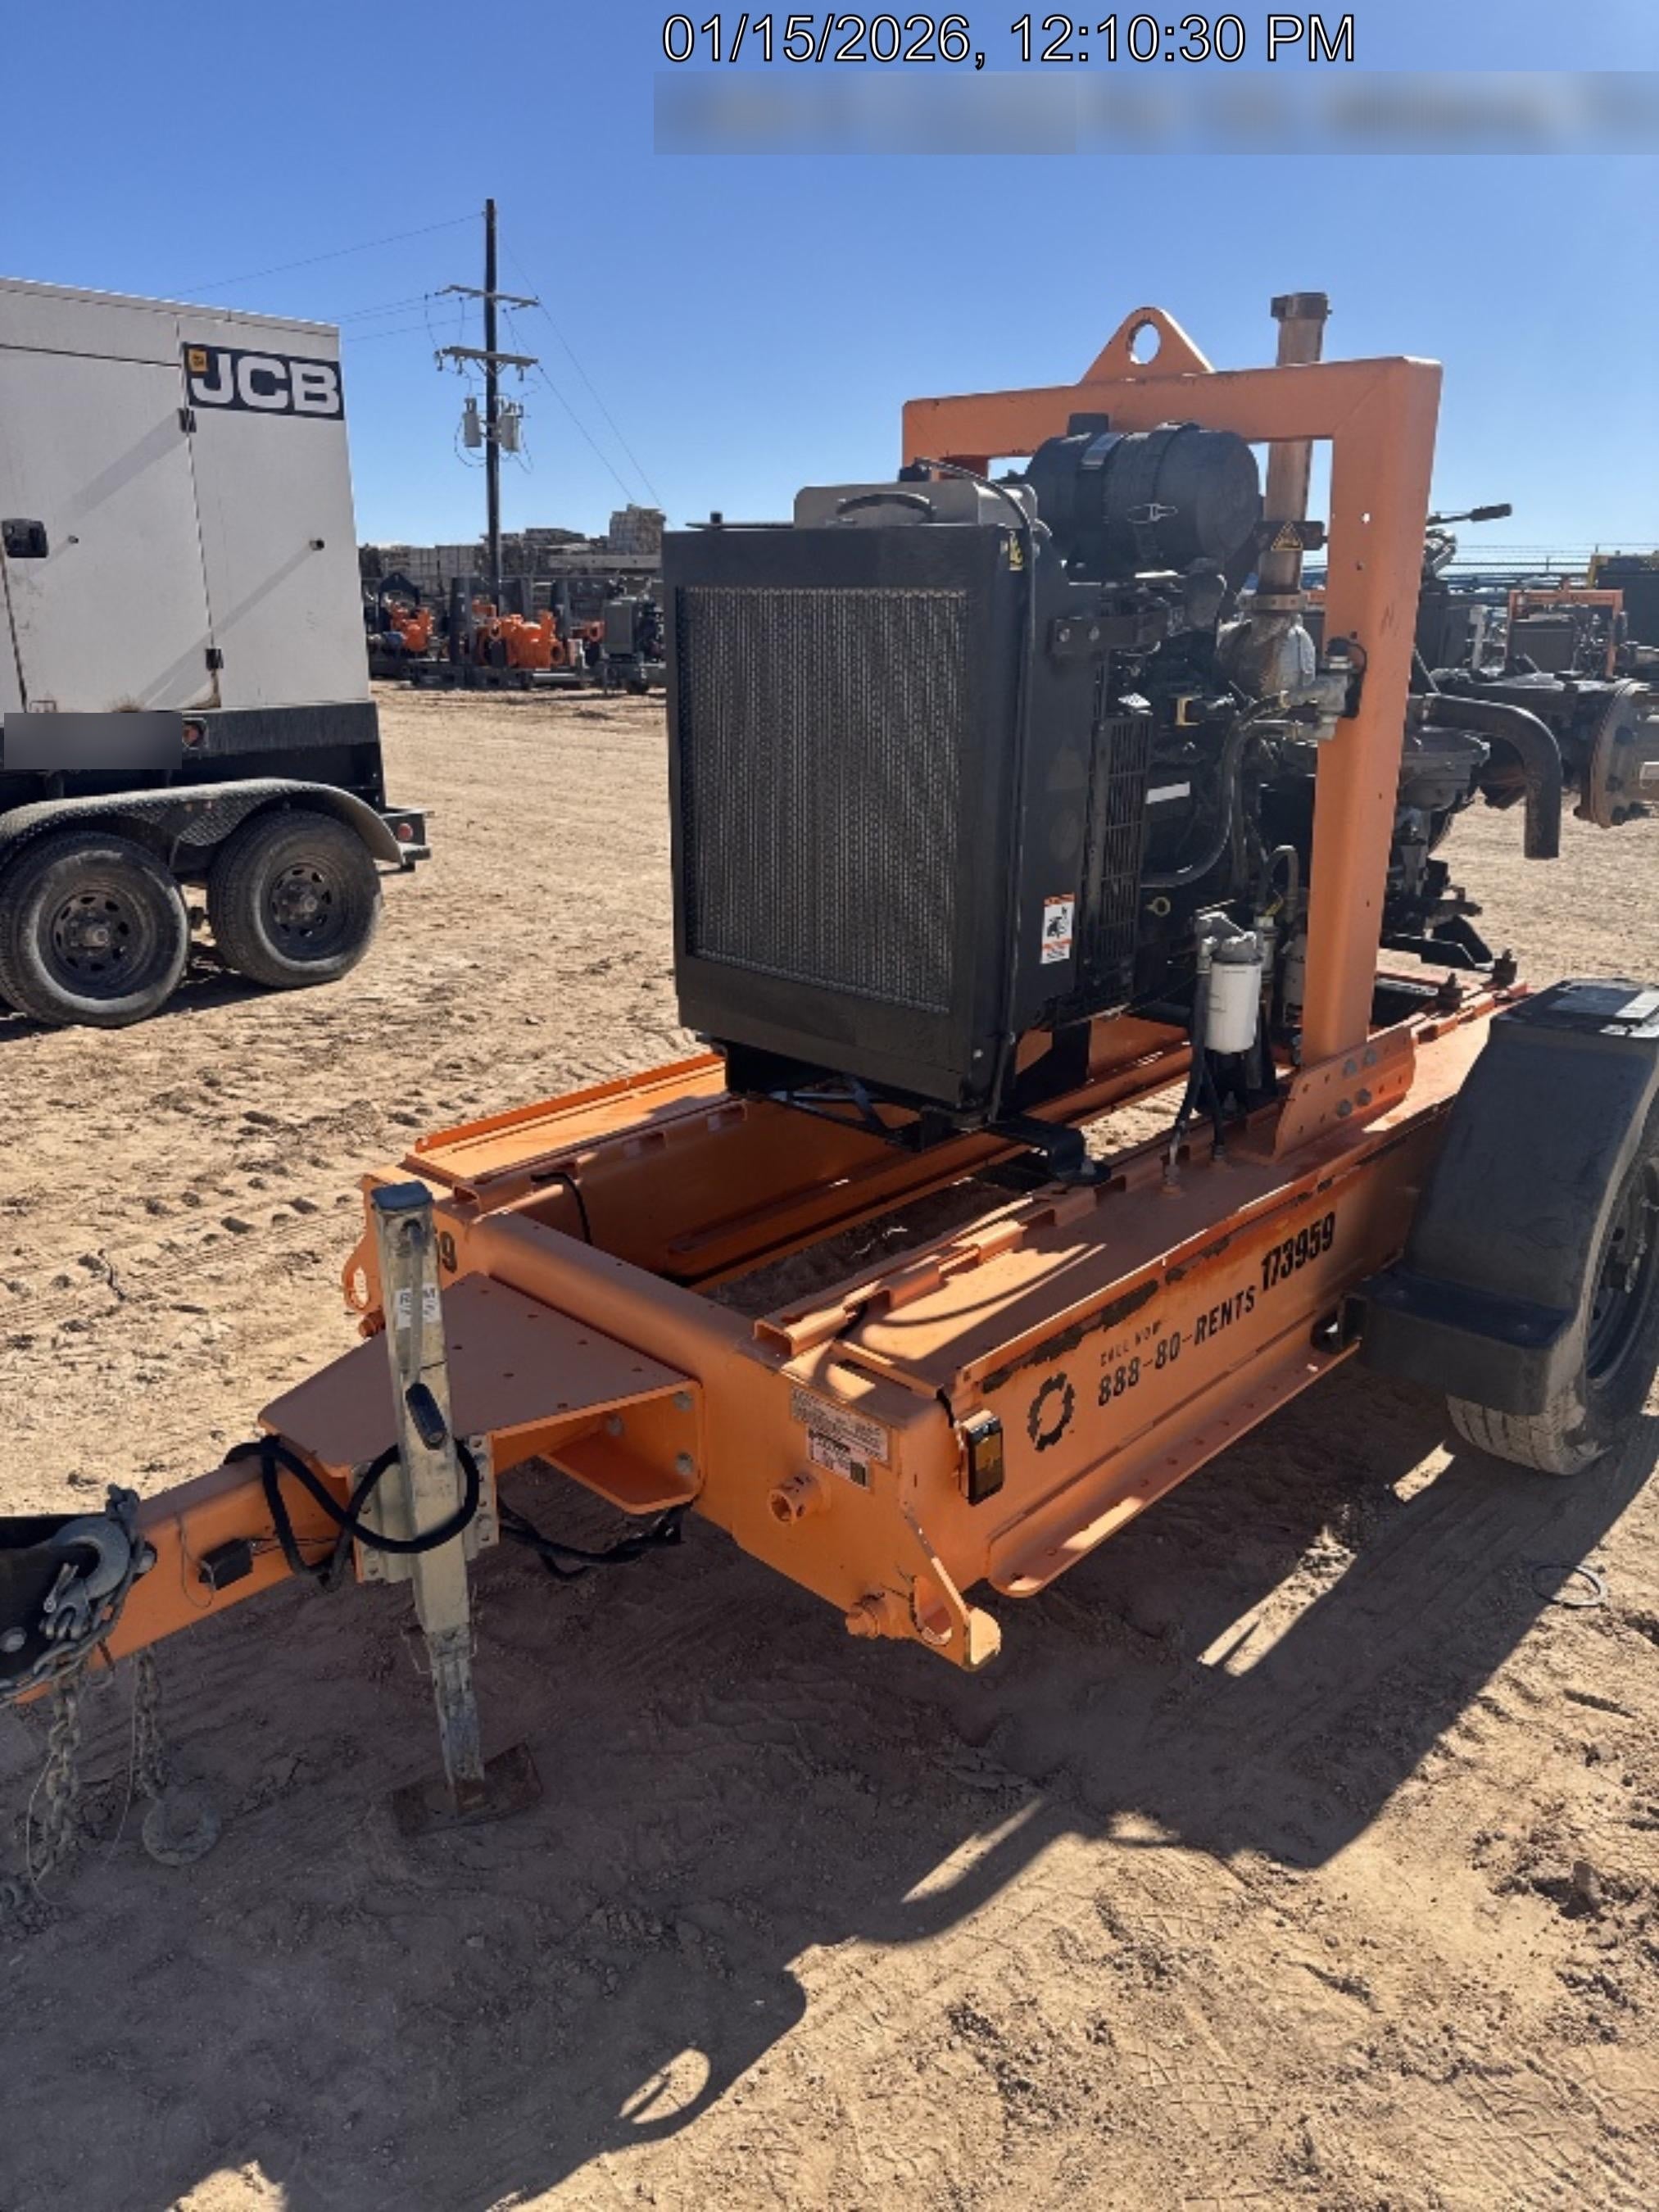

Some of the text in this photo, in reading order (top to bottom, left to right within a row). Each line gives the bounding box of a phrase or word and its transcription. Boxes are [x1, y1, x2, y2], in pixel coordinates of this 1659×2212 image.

[190, 353, 340, 413] JCB
[1261, 1211, 1335, 1291] 173959
[1098, 1285, 1257, 1406] 888-80-RENTS
